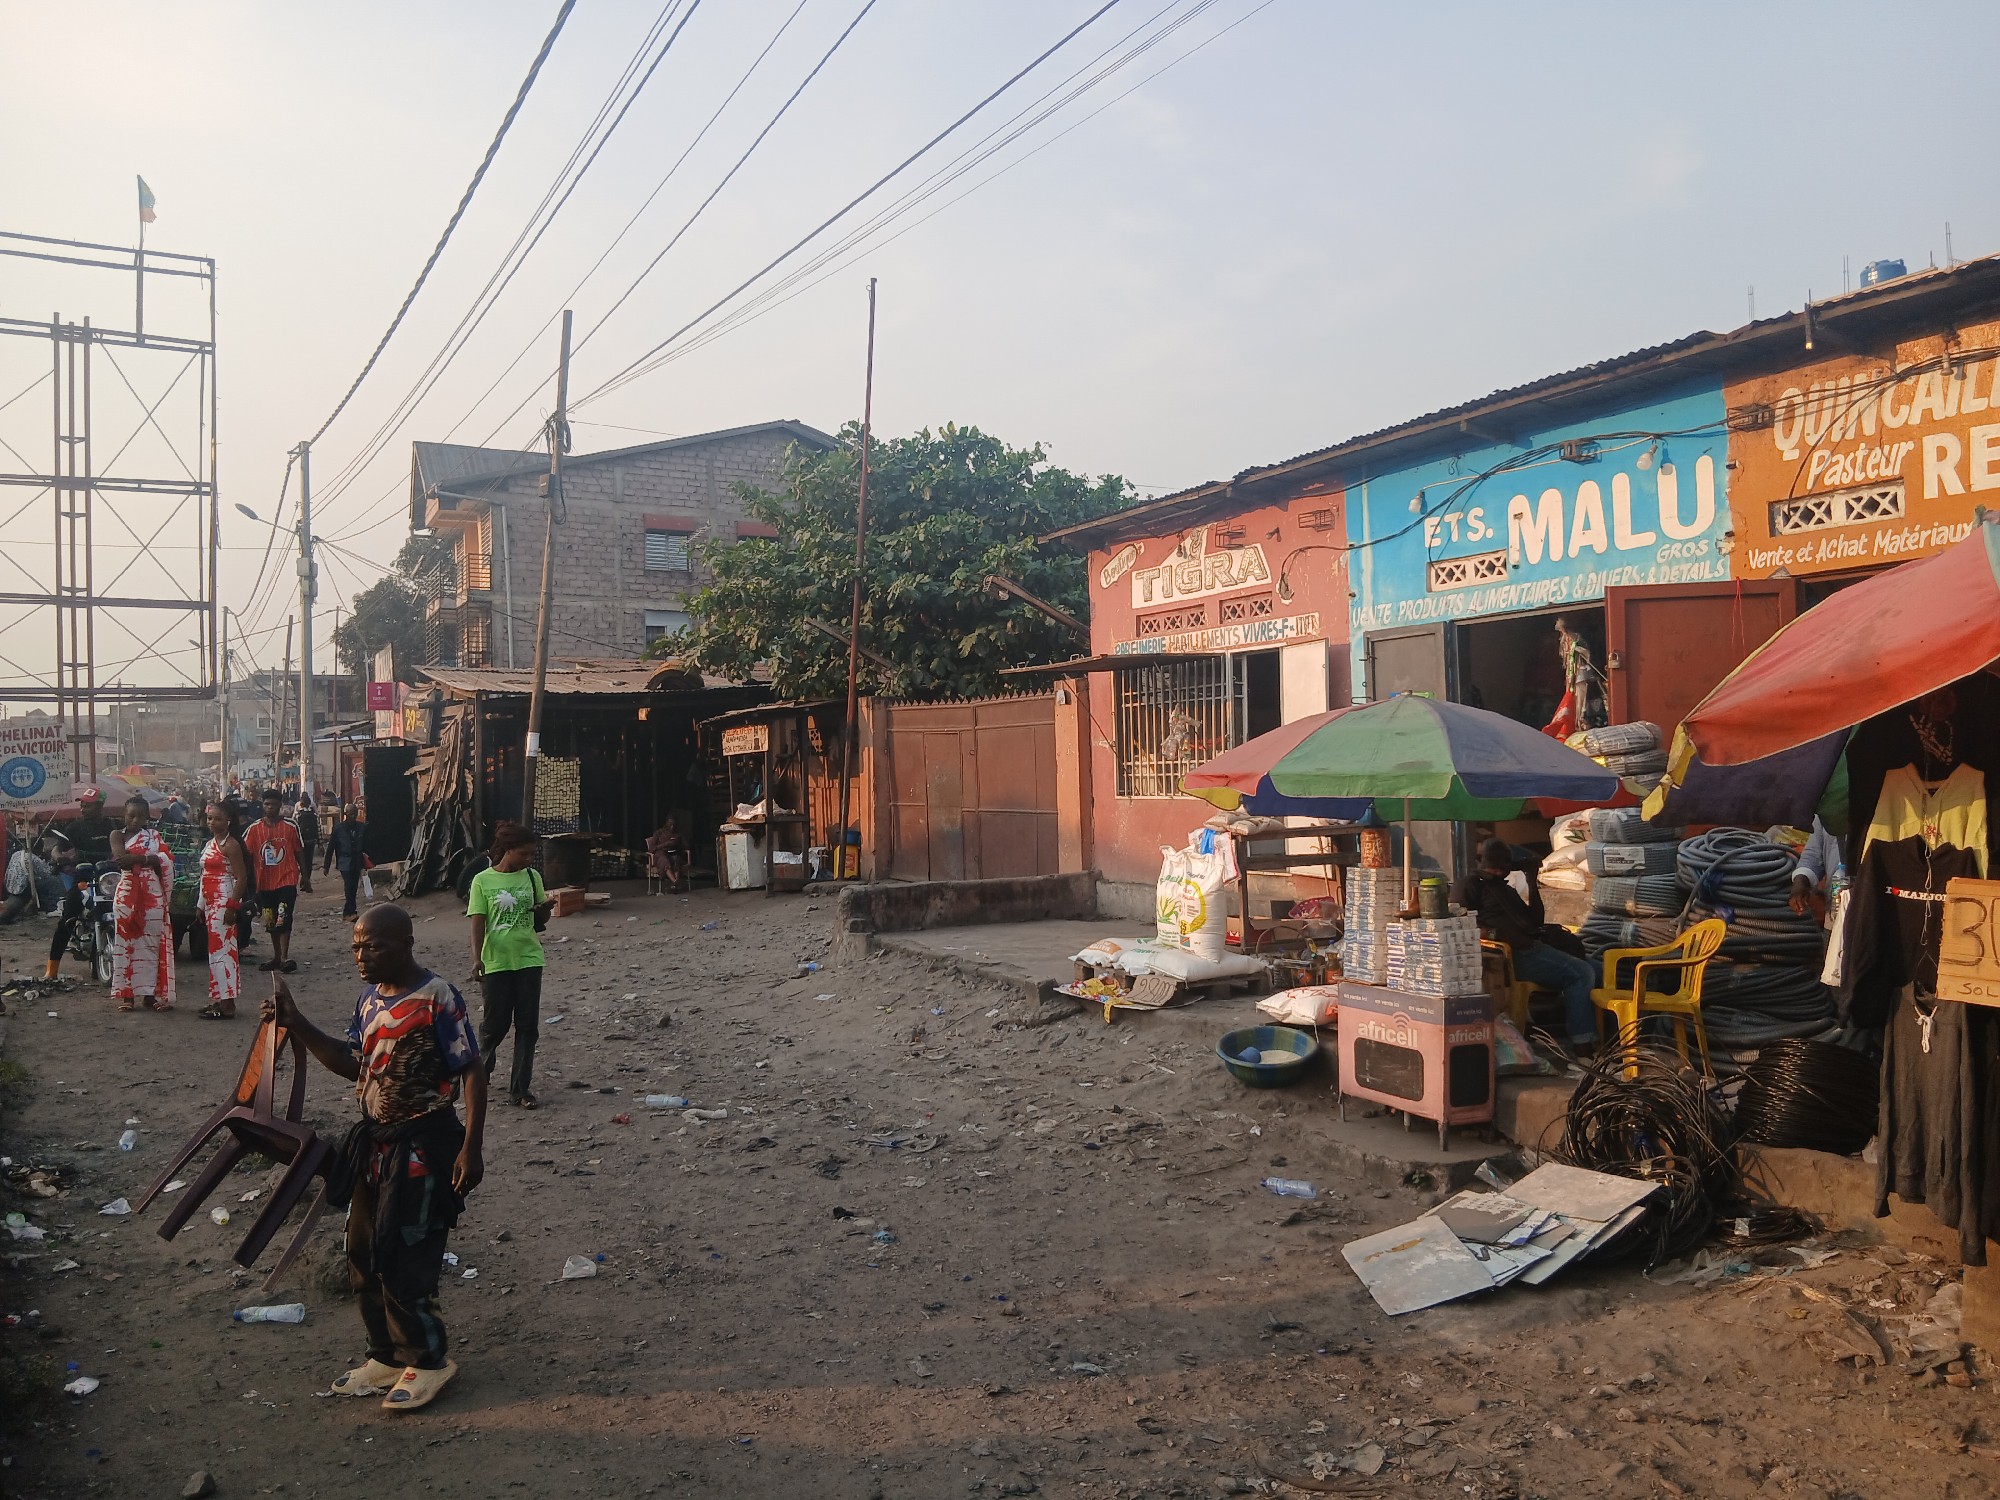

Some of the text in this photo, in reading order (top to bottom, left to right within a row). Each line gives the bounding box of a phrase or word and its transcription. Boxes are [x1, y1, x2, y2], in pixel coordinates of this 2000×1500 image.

[1806, 440, 1915, 490] Pasteur
[1424, 507, 1494, 548] ETS.
[1507, 455, 1716, 566] MALU
[1657, 539, 1709, 564] GROS
[1748, 548, 1793, 570] Vente
[1796, 545, 1813, 564] et
[1873, 521, 1974, 556] Matériaux
[1135, 545, 1268, 602] TIGRA
[1352, 603, 1392, 628] VENTE
[1397, 593, 1465, 622] PRODUITS
[1466, 576, 1570, 614] ALIMENTAIRES
[1659, 558, 1726, 584] DETAILS
[3, 740, 68, 755] DE VICTOIRE
[1358, 1020, 1418, 1047] africell
[1449, 1026, 1490, 1043] africell
